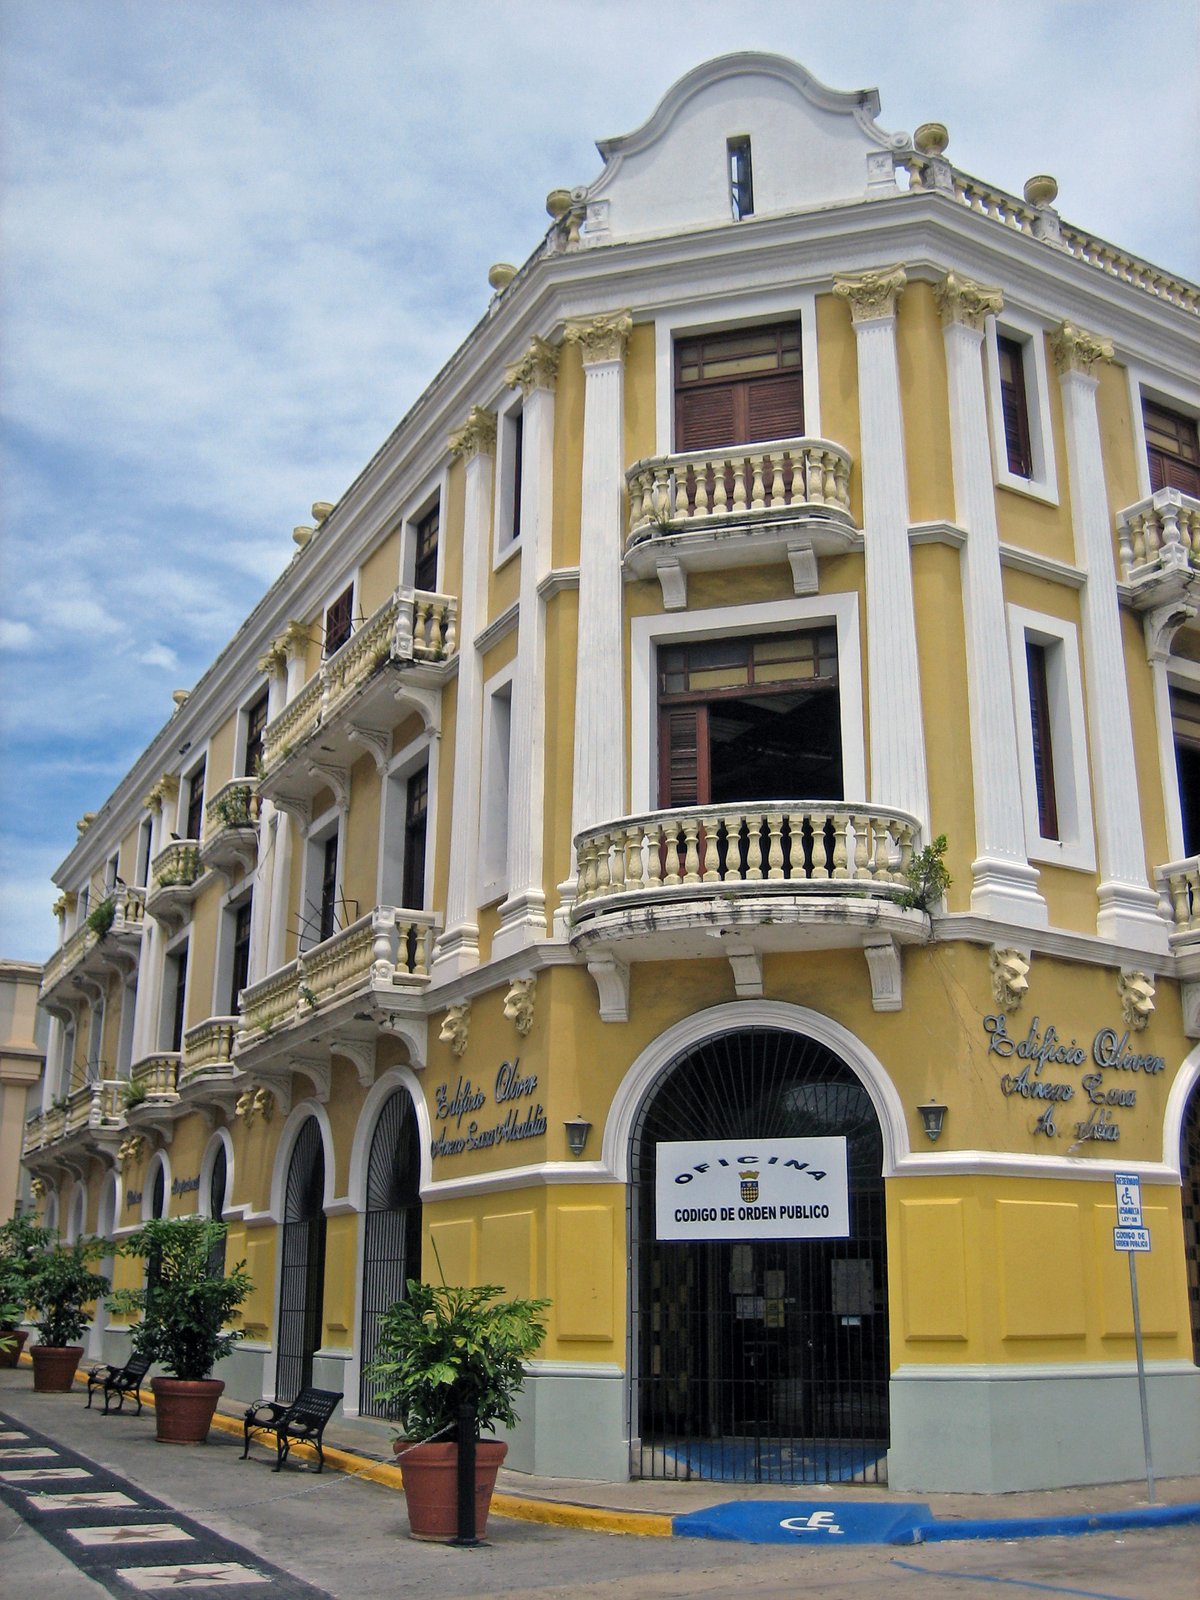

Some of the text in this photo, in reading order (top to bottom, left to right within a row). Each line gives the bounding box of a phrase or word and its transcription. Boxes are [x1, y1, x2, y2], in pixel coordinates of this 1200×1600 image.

[983, 1013, 1166, 1076] Edificio Oliver
[436, 1056, 538, 1129] Edificio Oliver
[1001, 1063, 1075, 1101] Anexo
[674, 1155, 828, 1185] OFICINA
[674, 1203, 829, 1223] CODIGO DE ORDEN PUBLICO
[1137, 1232, 1145, 1240] DE
